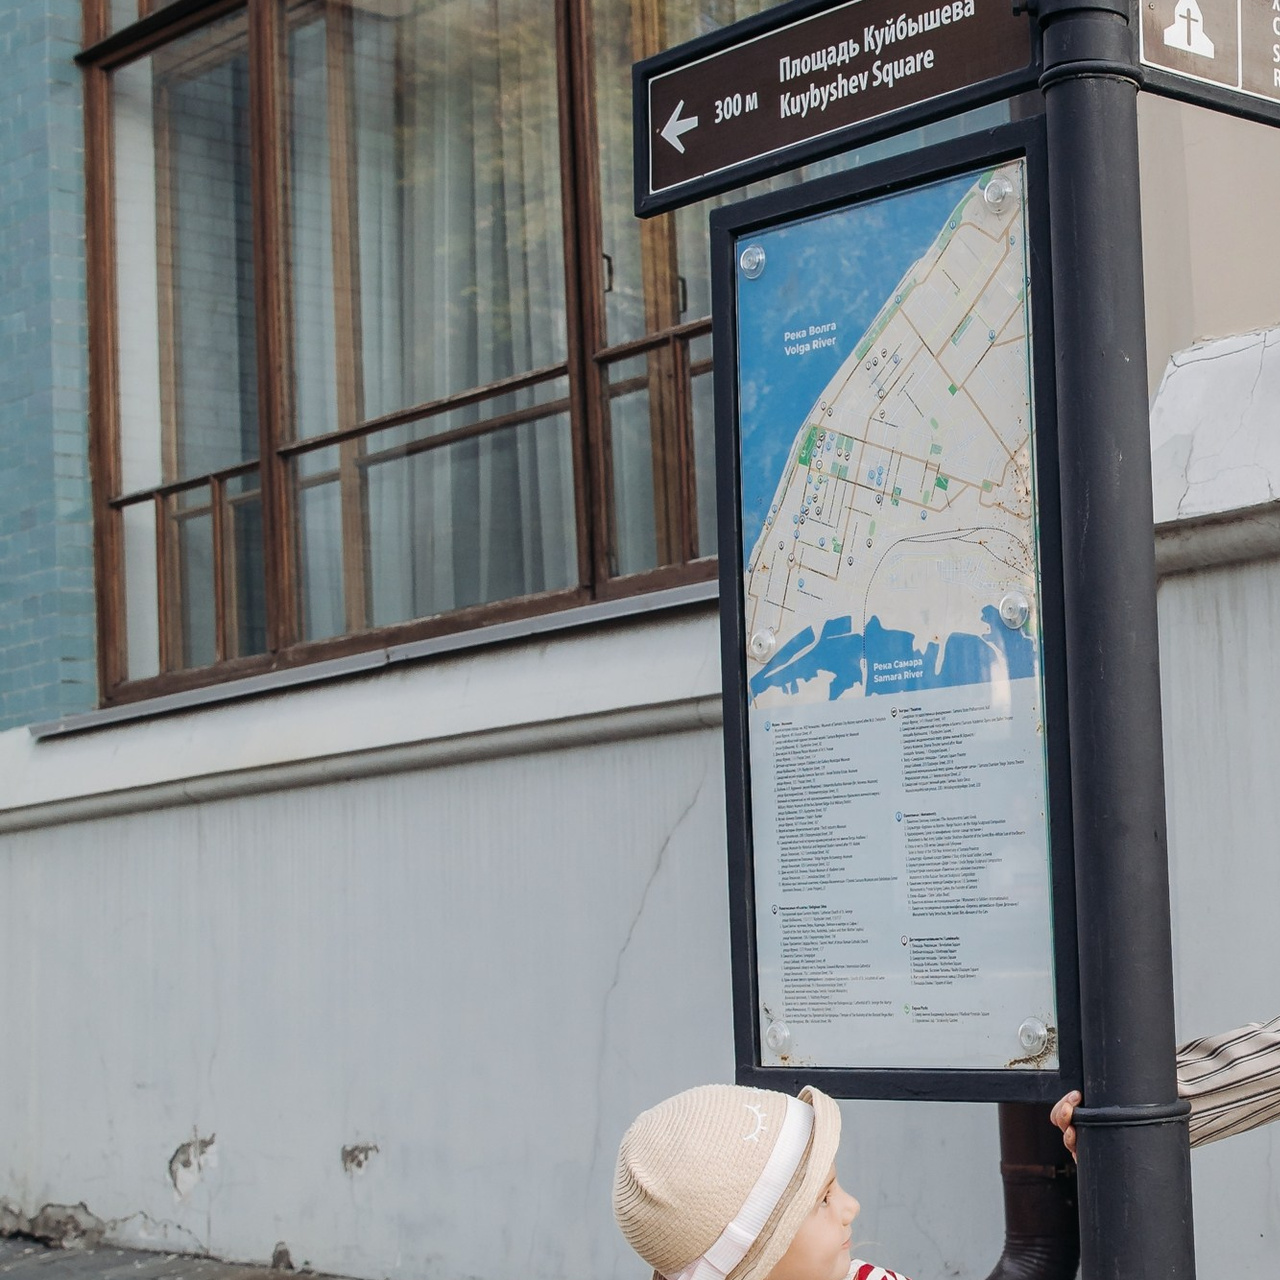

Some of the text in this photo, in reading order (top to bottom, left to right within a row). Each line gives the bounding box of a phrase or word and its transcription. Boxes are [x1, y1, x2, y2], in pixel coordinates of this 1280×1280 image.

[780, 39, 860, 82] Площадь
[780, 49, 934, 119] Kuybyshev Square
[715, 92, 758, 123] 300 м
[784, 322, 836, 342] Река Волга
[784, 337, 836, 356] Volga River
[873, 659, 923, 671] Река Самара
[874, 670, 923, 683] Samara River
